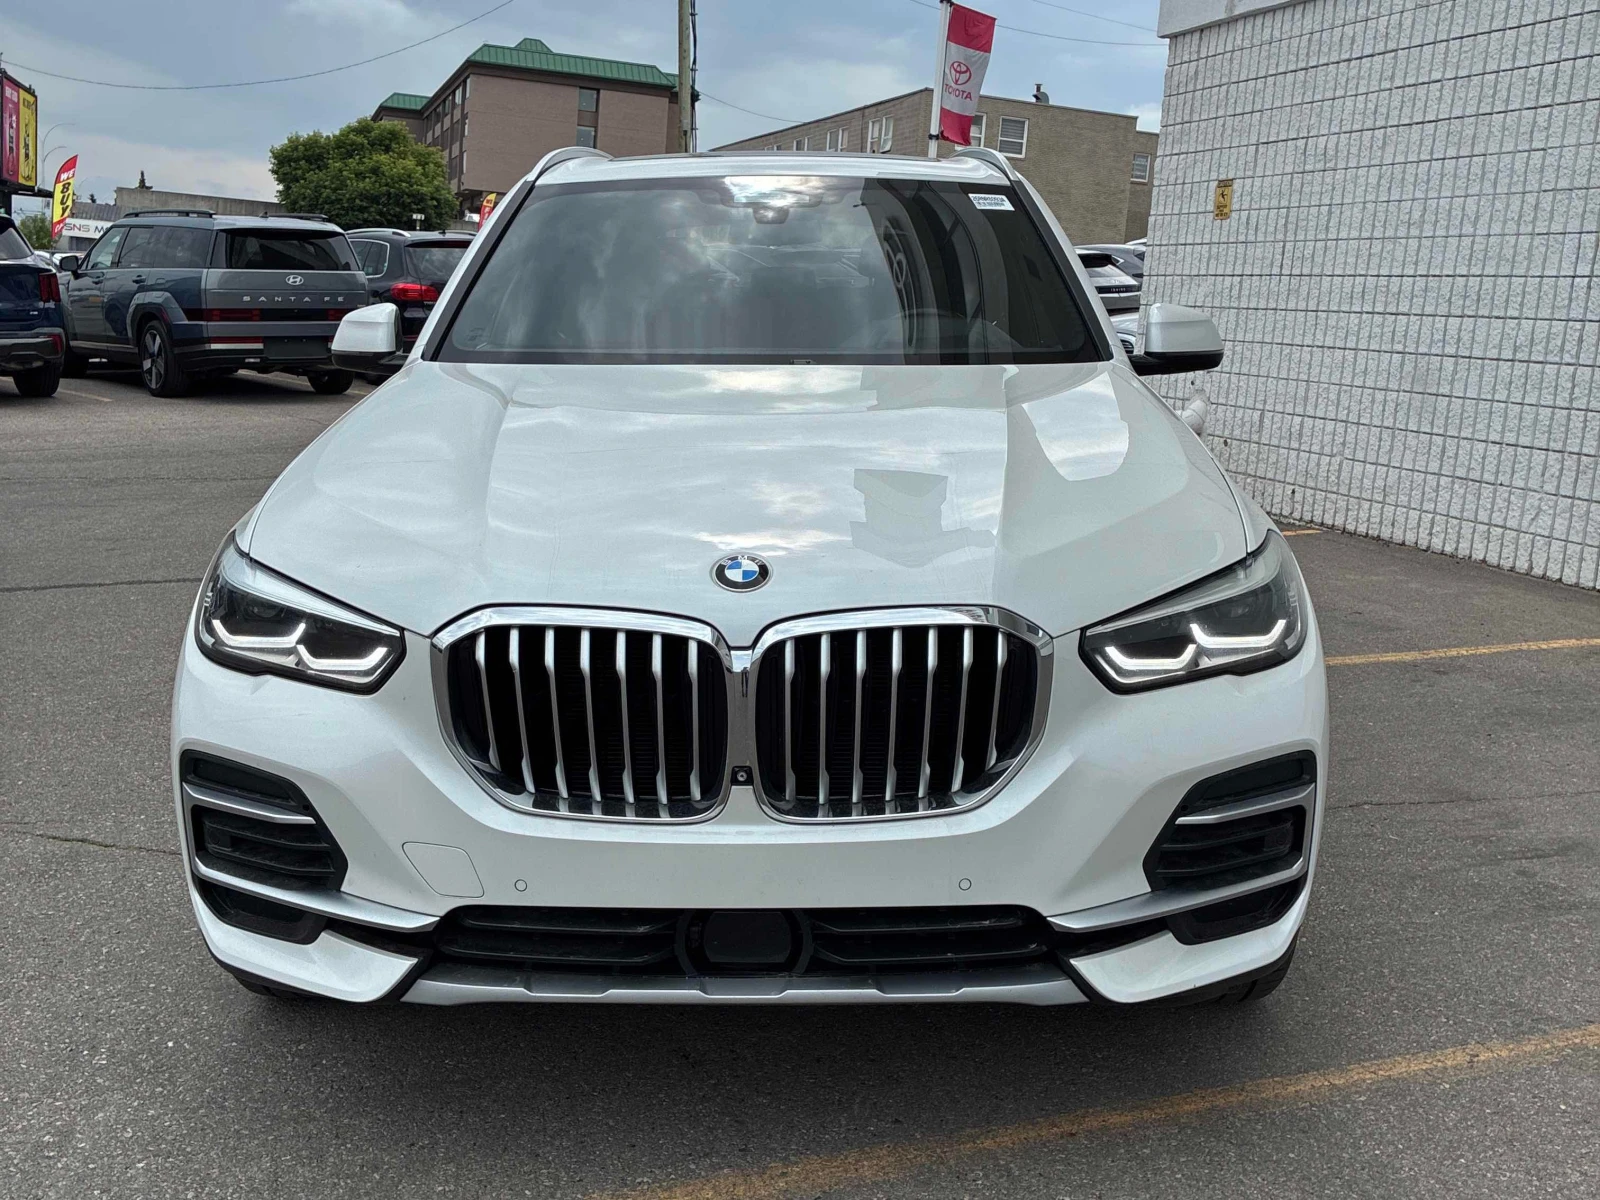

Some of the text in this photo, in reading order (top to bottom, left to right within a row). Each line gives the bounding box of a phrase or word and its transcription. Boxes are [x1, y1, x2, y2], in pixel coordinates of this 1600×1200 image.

[944, 83, 973, 101] TOYOTA
[60, 168, 76, 181] WE
[60, 182, 71, 217] BUY
[65, 223, 90, 232] SNS
[720, 555, 765, 566] BMW
